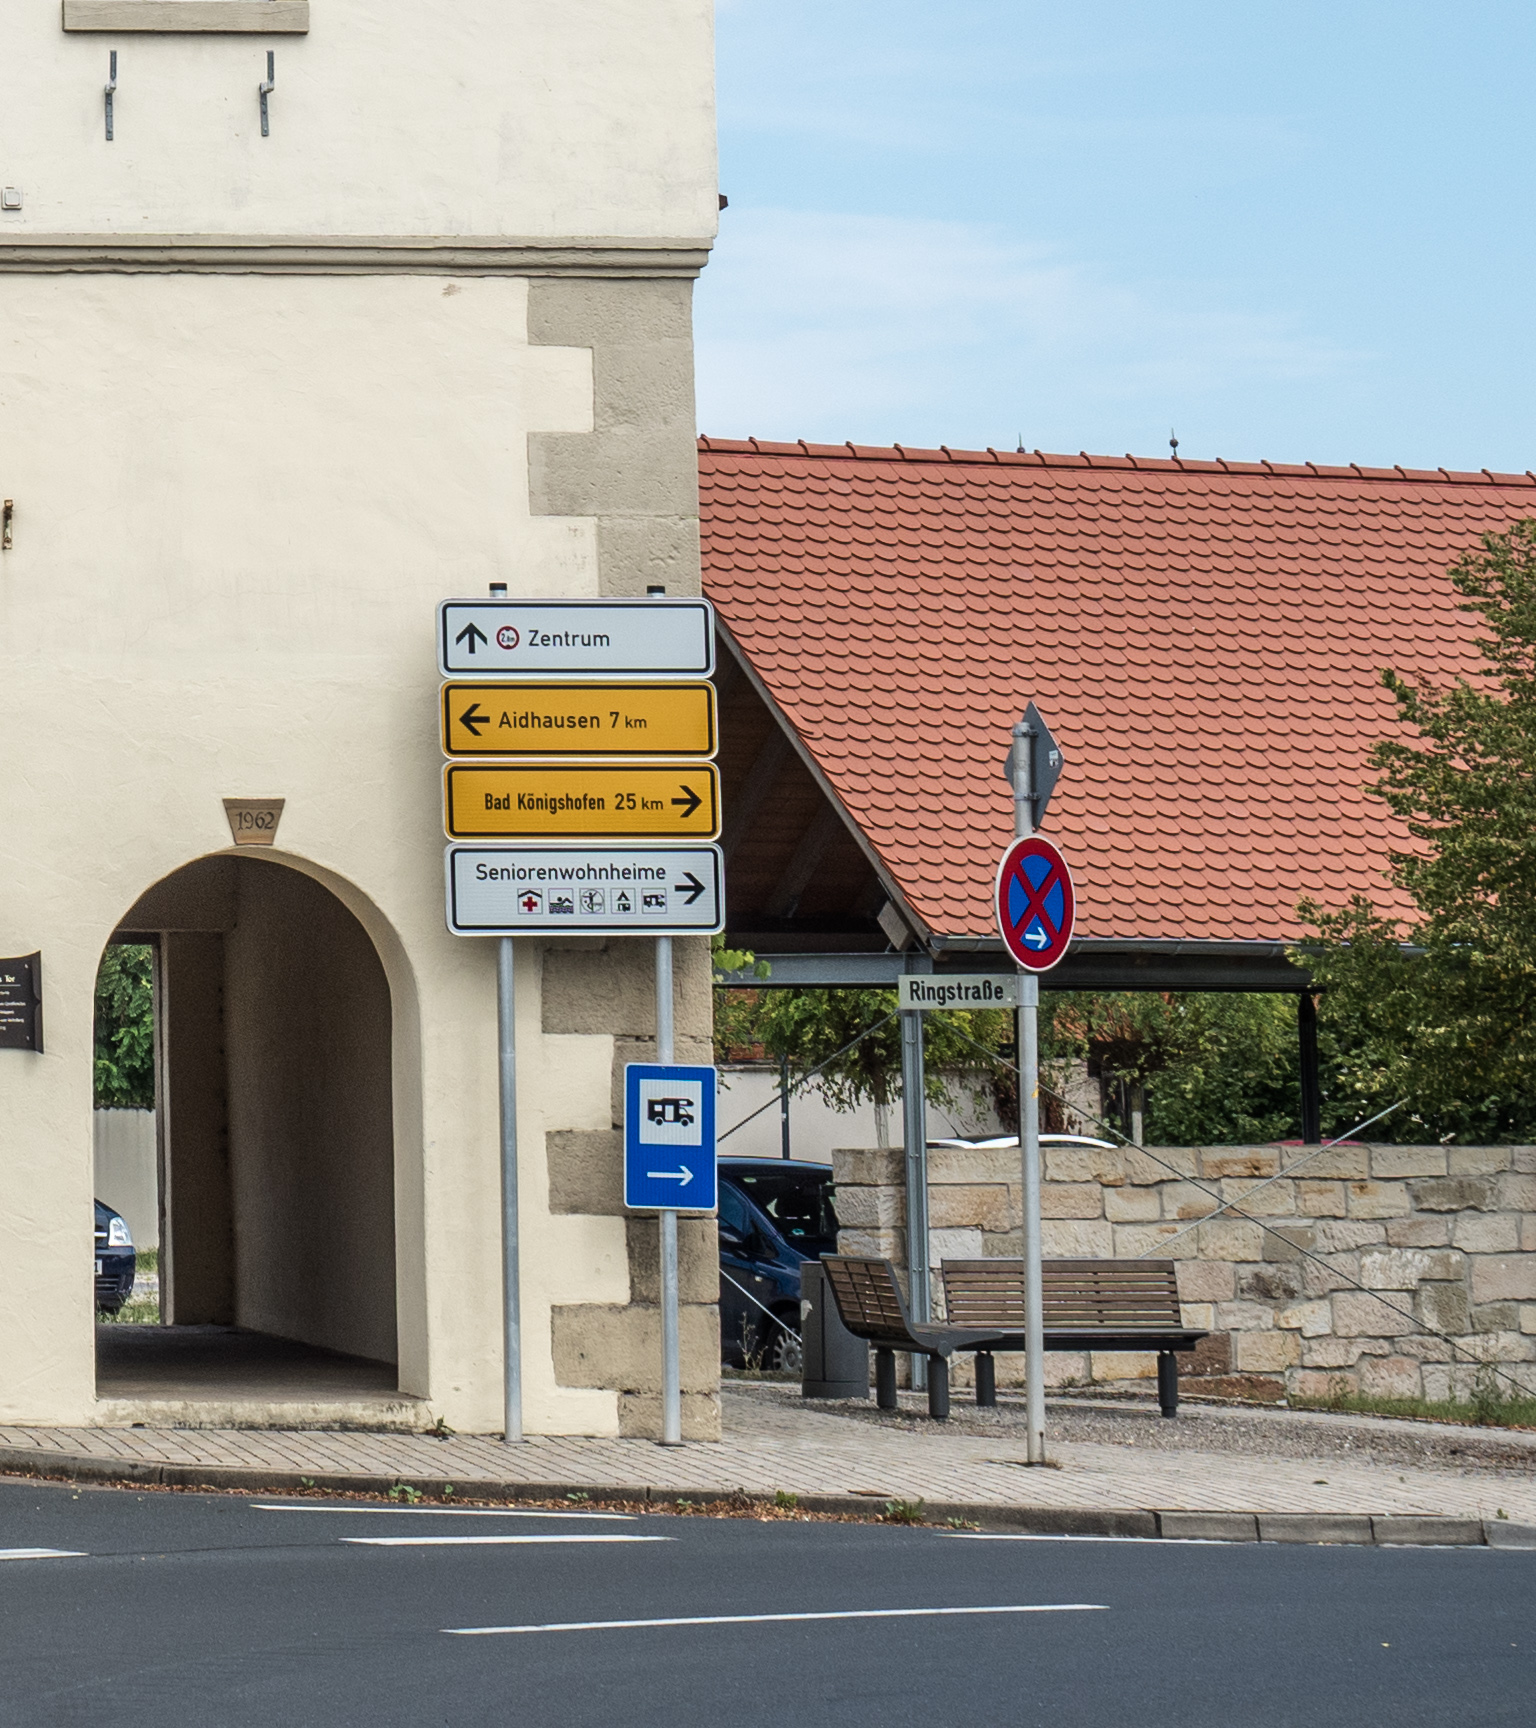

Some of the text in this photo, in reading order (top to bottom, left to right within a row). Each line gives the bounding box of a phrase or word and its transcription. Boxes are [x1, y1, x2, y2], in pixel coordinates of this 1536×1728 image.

[528, 629, 610, 647] Zentrum
[498, 711, 647, 729] Aidhausen 7 km
[484, 792, 664, 815] Bad Königshofen 25 km
[235, 811, 275, 830] 1962
[476, 863, 666, 880] Seniorenwohnheime
[909, 979, 1004, 1006] Ringstraße
